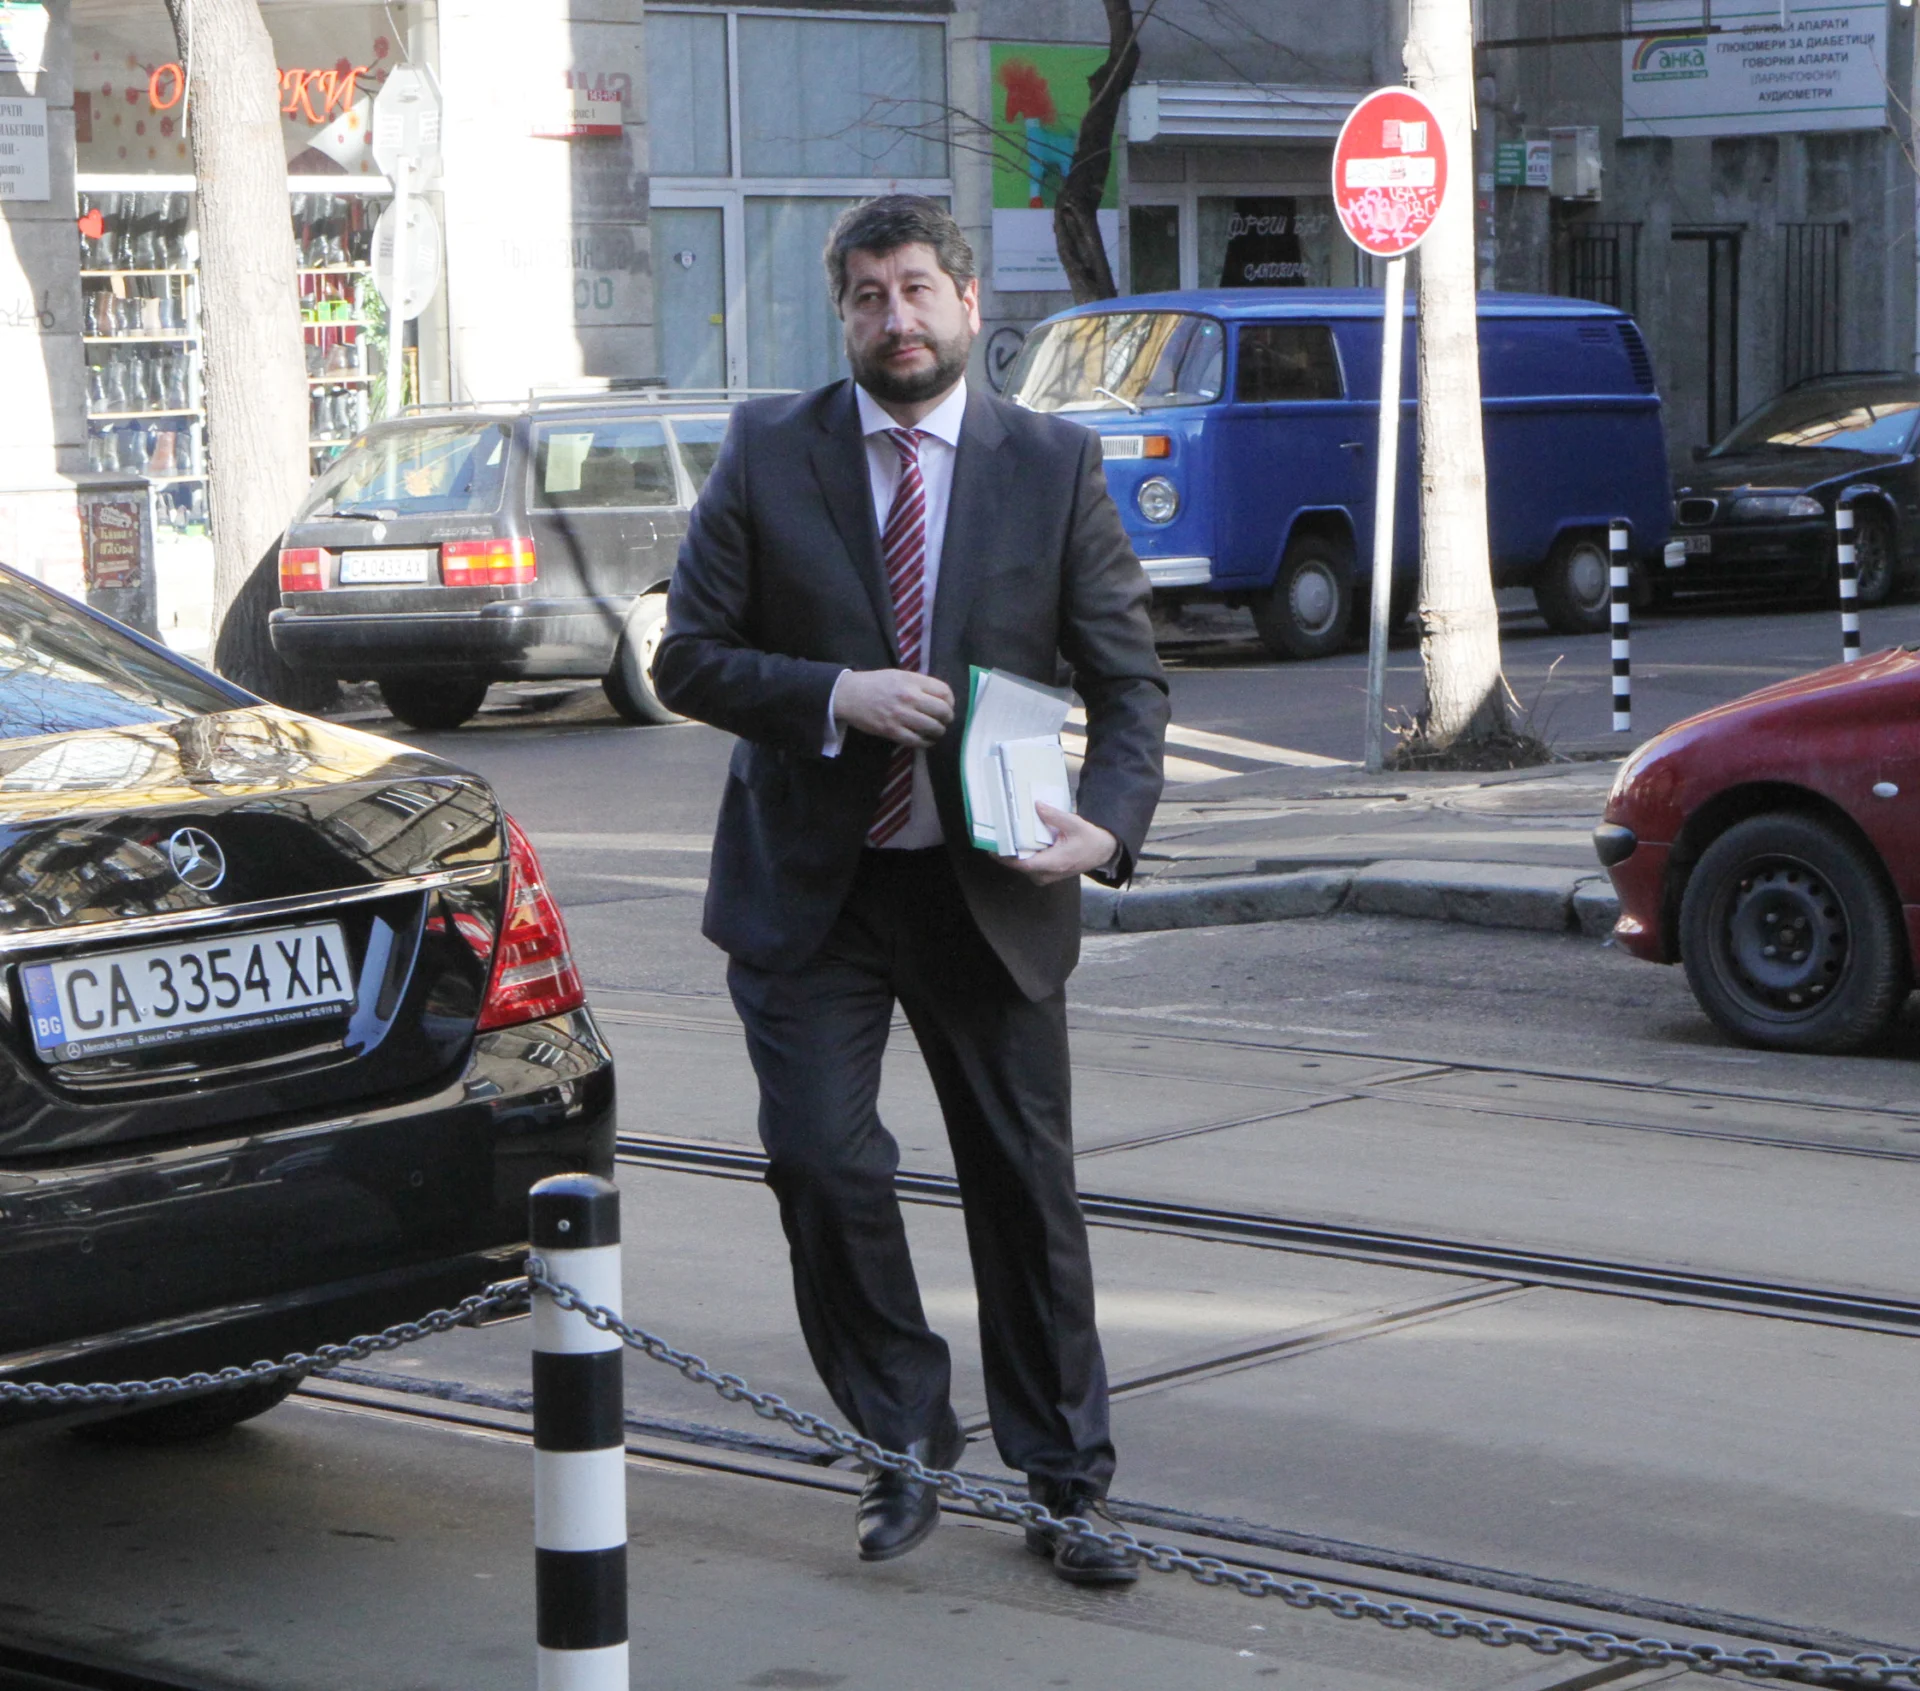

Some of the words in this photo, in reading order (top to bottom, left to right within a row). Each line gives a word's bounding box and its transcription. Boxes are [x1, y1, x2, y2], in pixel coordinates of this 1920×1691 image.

[1797, 18, 1849, 32] АПАРАТИ
[1716, 39, 1786, 53] ГЛЮКОМЕРИ
[1789, 37, 1804, 49] ЗА
[1806, 34, 1876, 49] ДИАБЕТИЦИ
[1742, 55, 1794, 69] ГОВОРНИ
[1797, 52, 1849, 65] АПАРАТИ
[1758, 87, 1833, 102] АУДИОМЕТРИ
[148, 943, 271, 1018] 3354
[37, 1016, 63, 1038] BG
